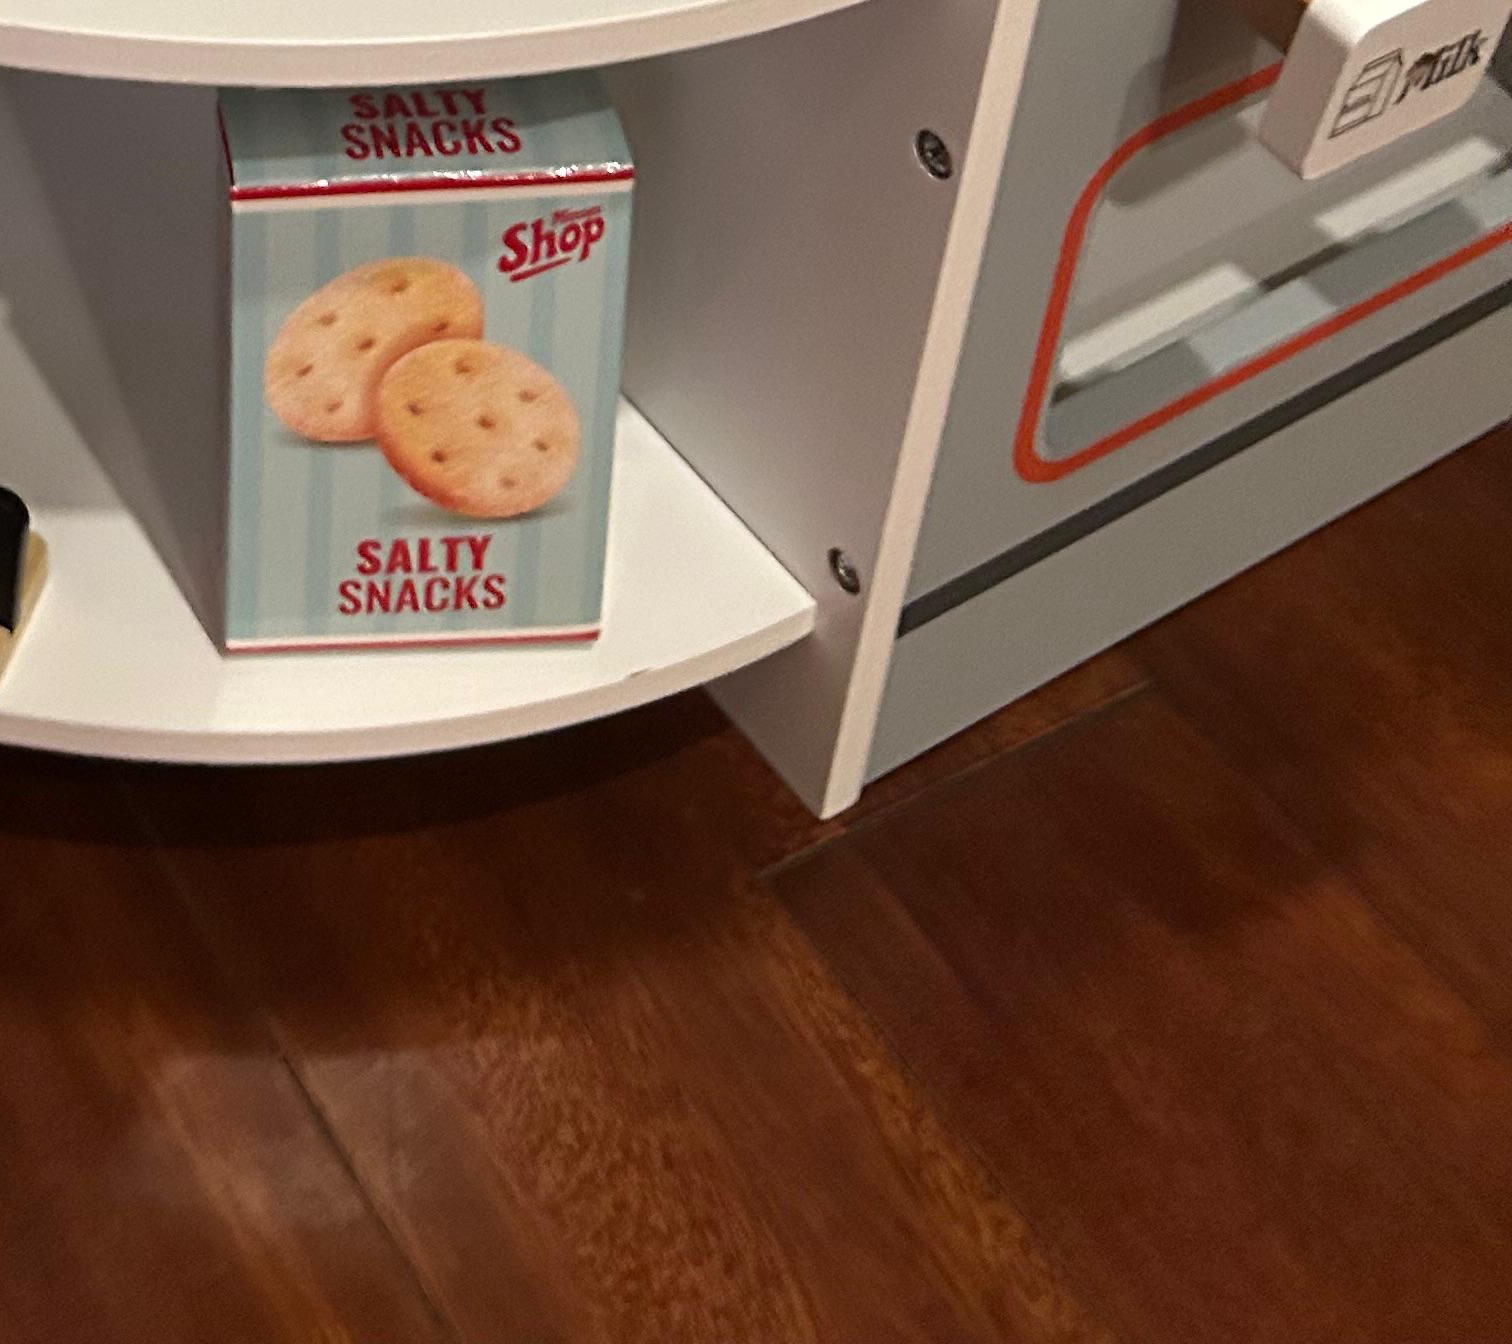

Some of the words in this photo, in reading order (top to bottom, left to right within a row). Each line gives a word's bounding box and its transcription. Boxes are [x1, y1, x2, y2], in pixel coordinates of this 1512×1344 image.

[1393, 29, 1489, 105] Milk
[349, 88, 487, 121] SALTY
[341, 116, 522, 161] SNACKS
[497, 216, 605, 282] Shop
[355, 533, 493, 576] SALTY
[337, 574, 507, 617] SNACKS
